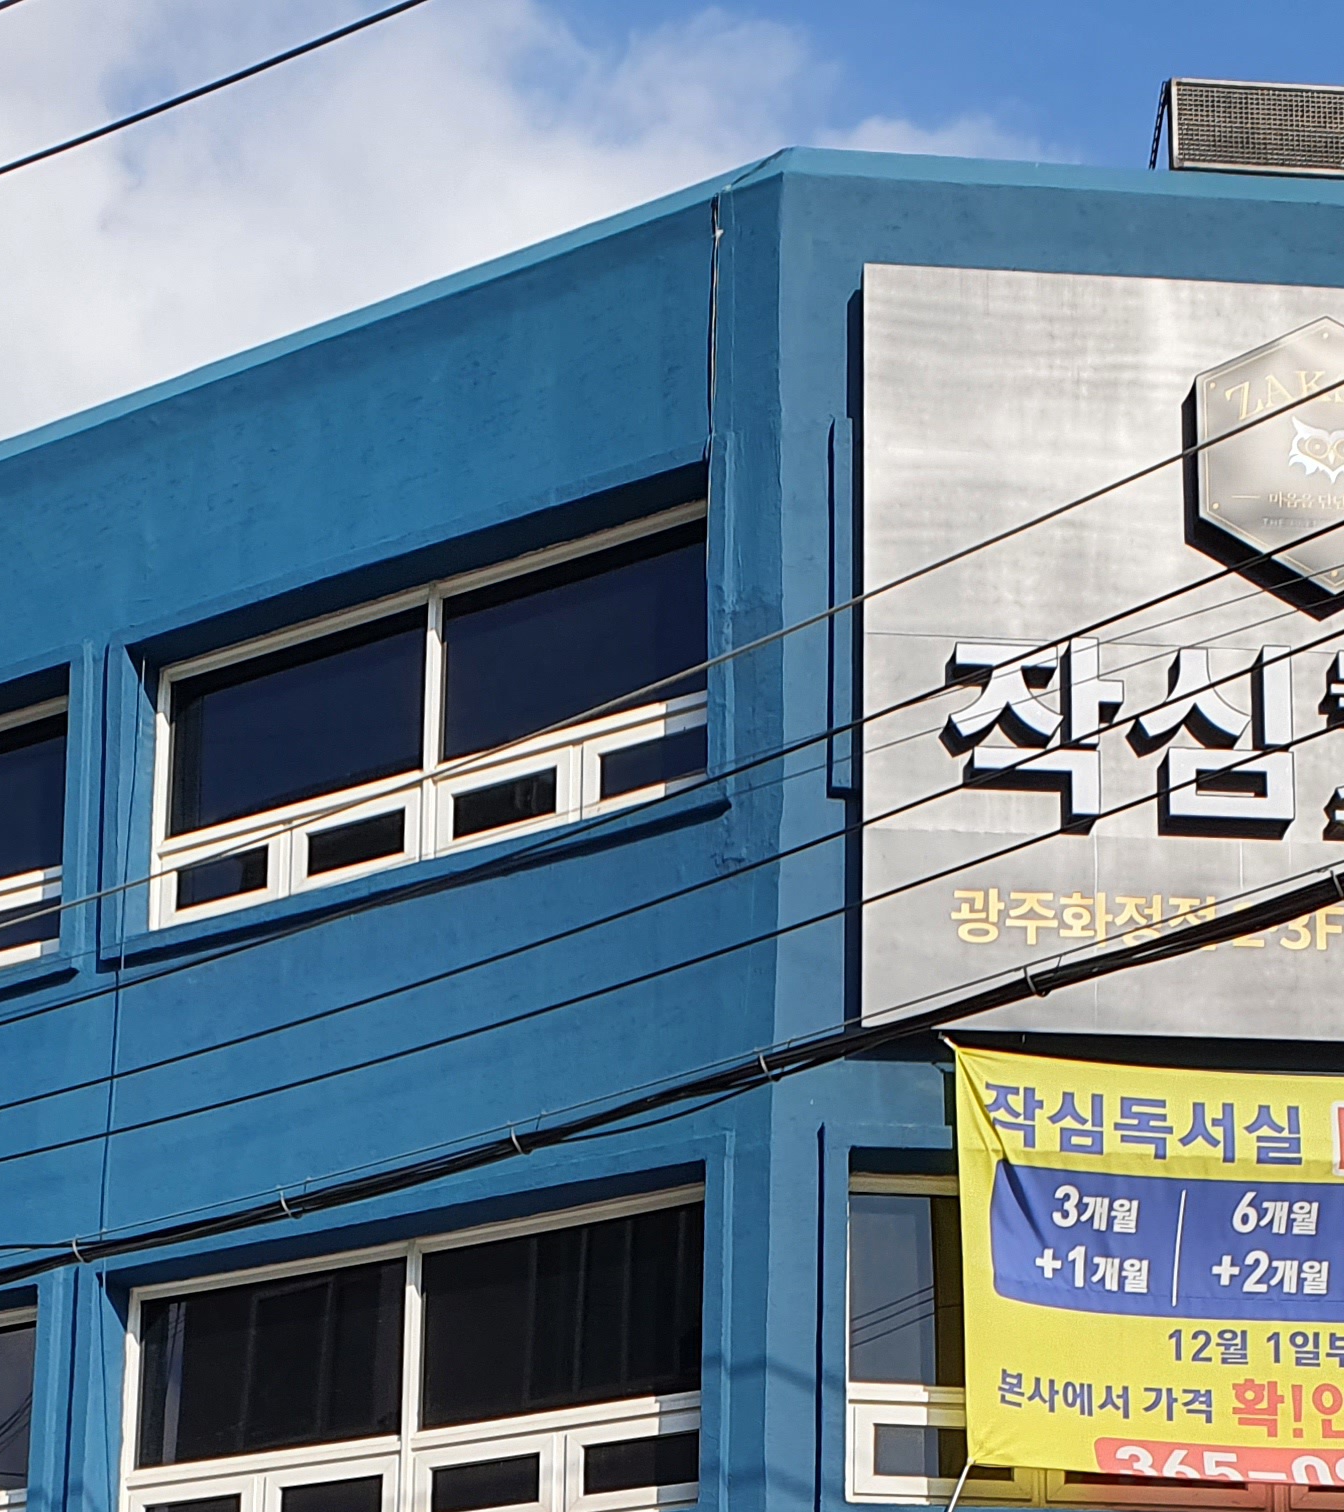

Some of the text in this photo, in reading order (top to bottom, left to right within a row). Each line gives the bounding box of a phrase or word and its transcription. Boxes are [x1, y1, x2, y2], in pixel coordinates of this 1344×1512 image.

[946, 636, 1297, 826] 작심
[985, 1081, 1304, 1166] 작심독서실
[1052, 1186, 1139, 1233] 3개월
[1232, 1192, 1319, 1236] 6개월
[1035, 1246, 1150, 1293] +1개월
[1211, 1251, 1329, 1296] +2개월
[1167, 1328, 1250, 1366] 12월
[997, 1368, 1131, 1419] 본사에서
[1143, 1384, 1214, 1423] 가격
